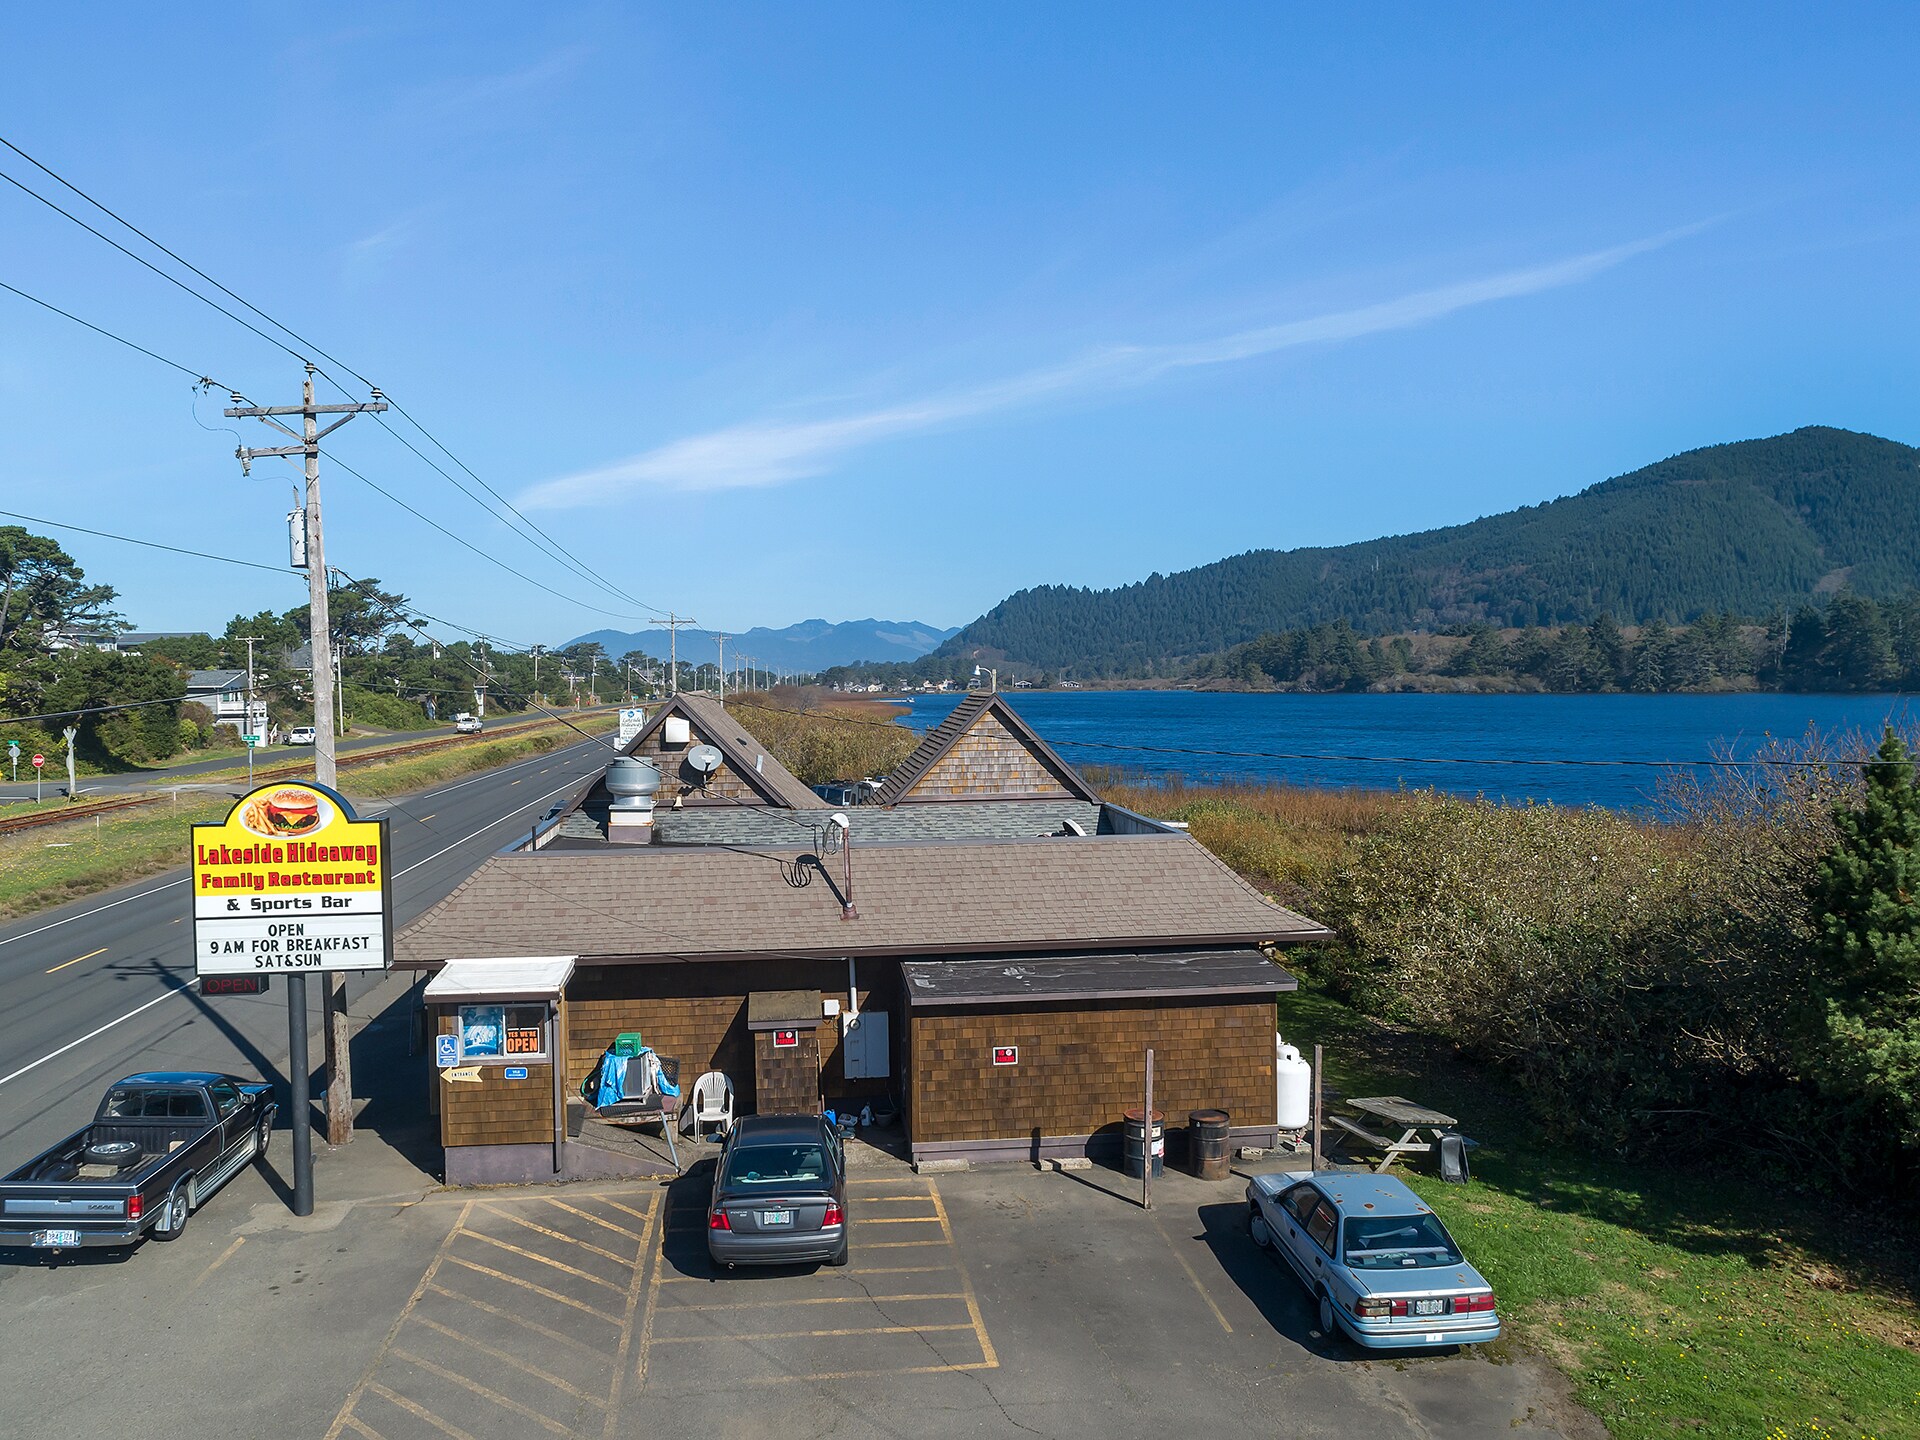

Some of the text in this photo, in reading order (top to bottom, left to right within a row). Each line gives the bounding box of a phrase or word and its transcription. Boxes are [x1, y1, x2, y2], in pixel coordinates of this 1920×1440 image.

[198, 842, 377, 866] Lakeside Hideaway
[201, 870, 375, 890] Family Restaurant
[226, 896, 352, 912] & Sports Bar
[268, 923, 304, 936] OPEN
[210, 936, 369, 954] 9 AM FOR BREAKFAST
[255, 954, 321, 968] SAT&SUN
[207, 978, 257, 993] OPEN
[507, 1037, 538, 1052] OPEN
